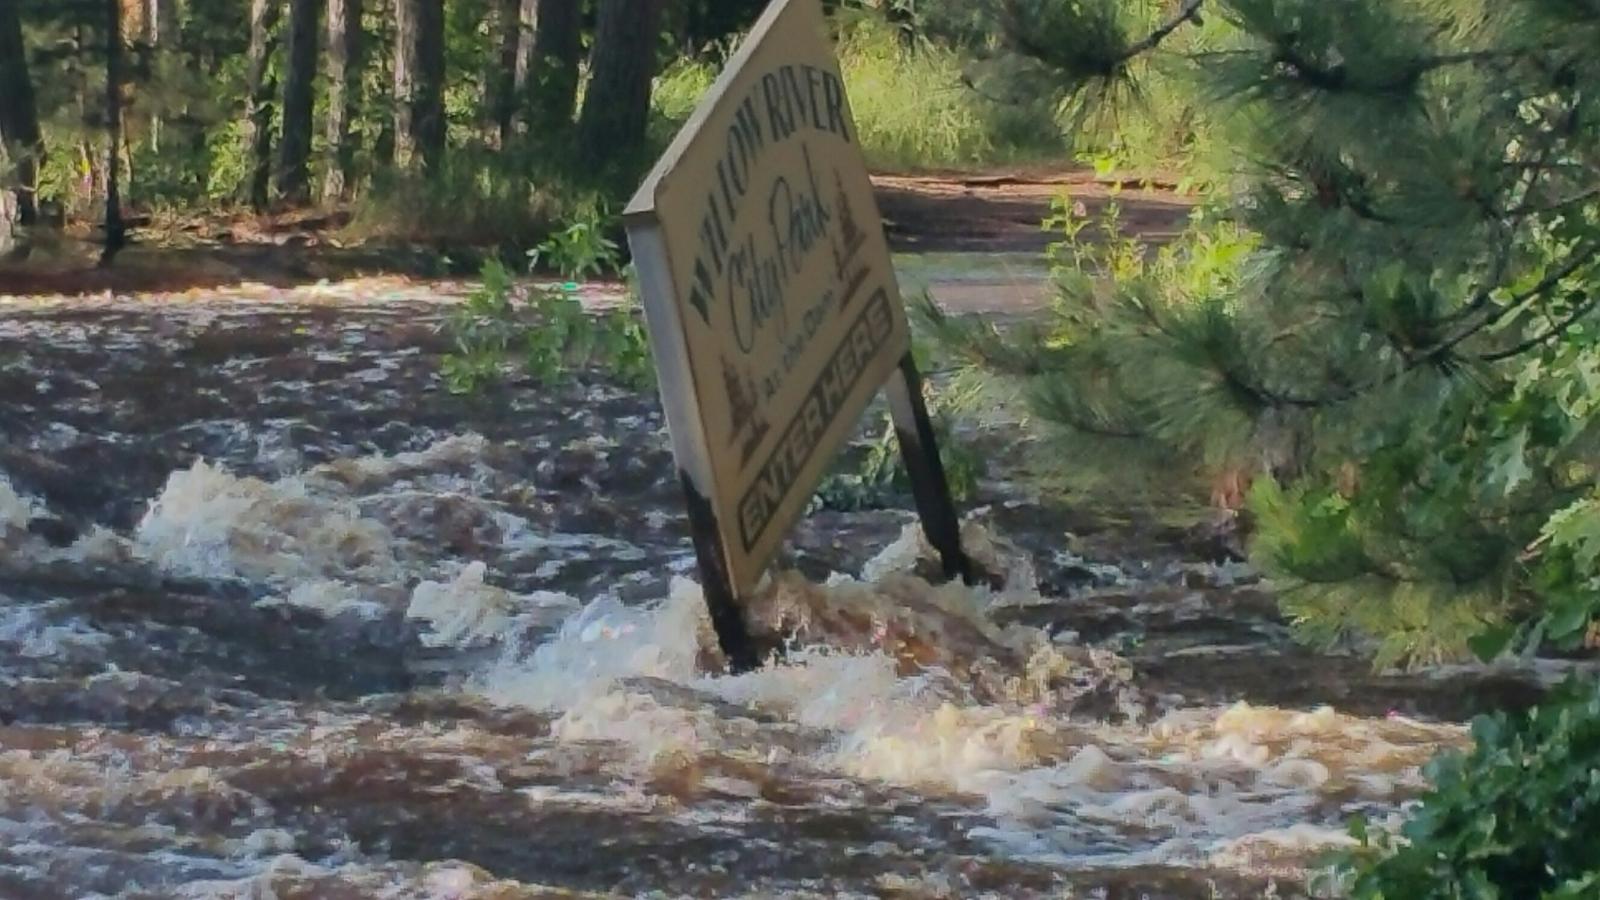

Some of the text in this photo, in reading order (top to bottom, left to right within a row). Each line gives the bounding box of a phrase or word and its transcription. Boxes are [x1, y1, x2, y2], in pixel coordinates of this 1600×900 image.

[689, 65, 850, 327] WILLOW RIVER
[728, 142, 830, 354] City Park
[742, 295, 890, 547] ENTER HERE
